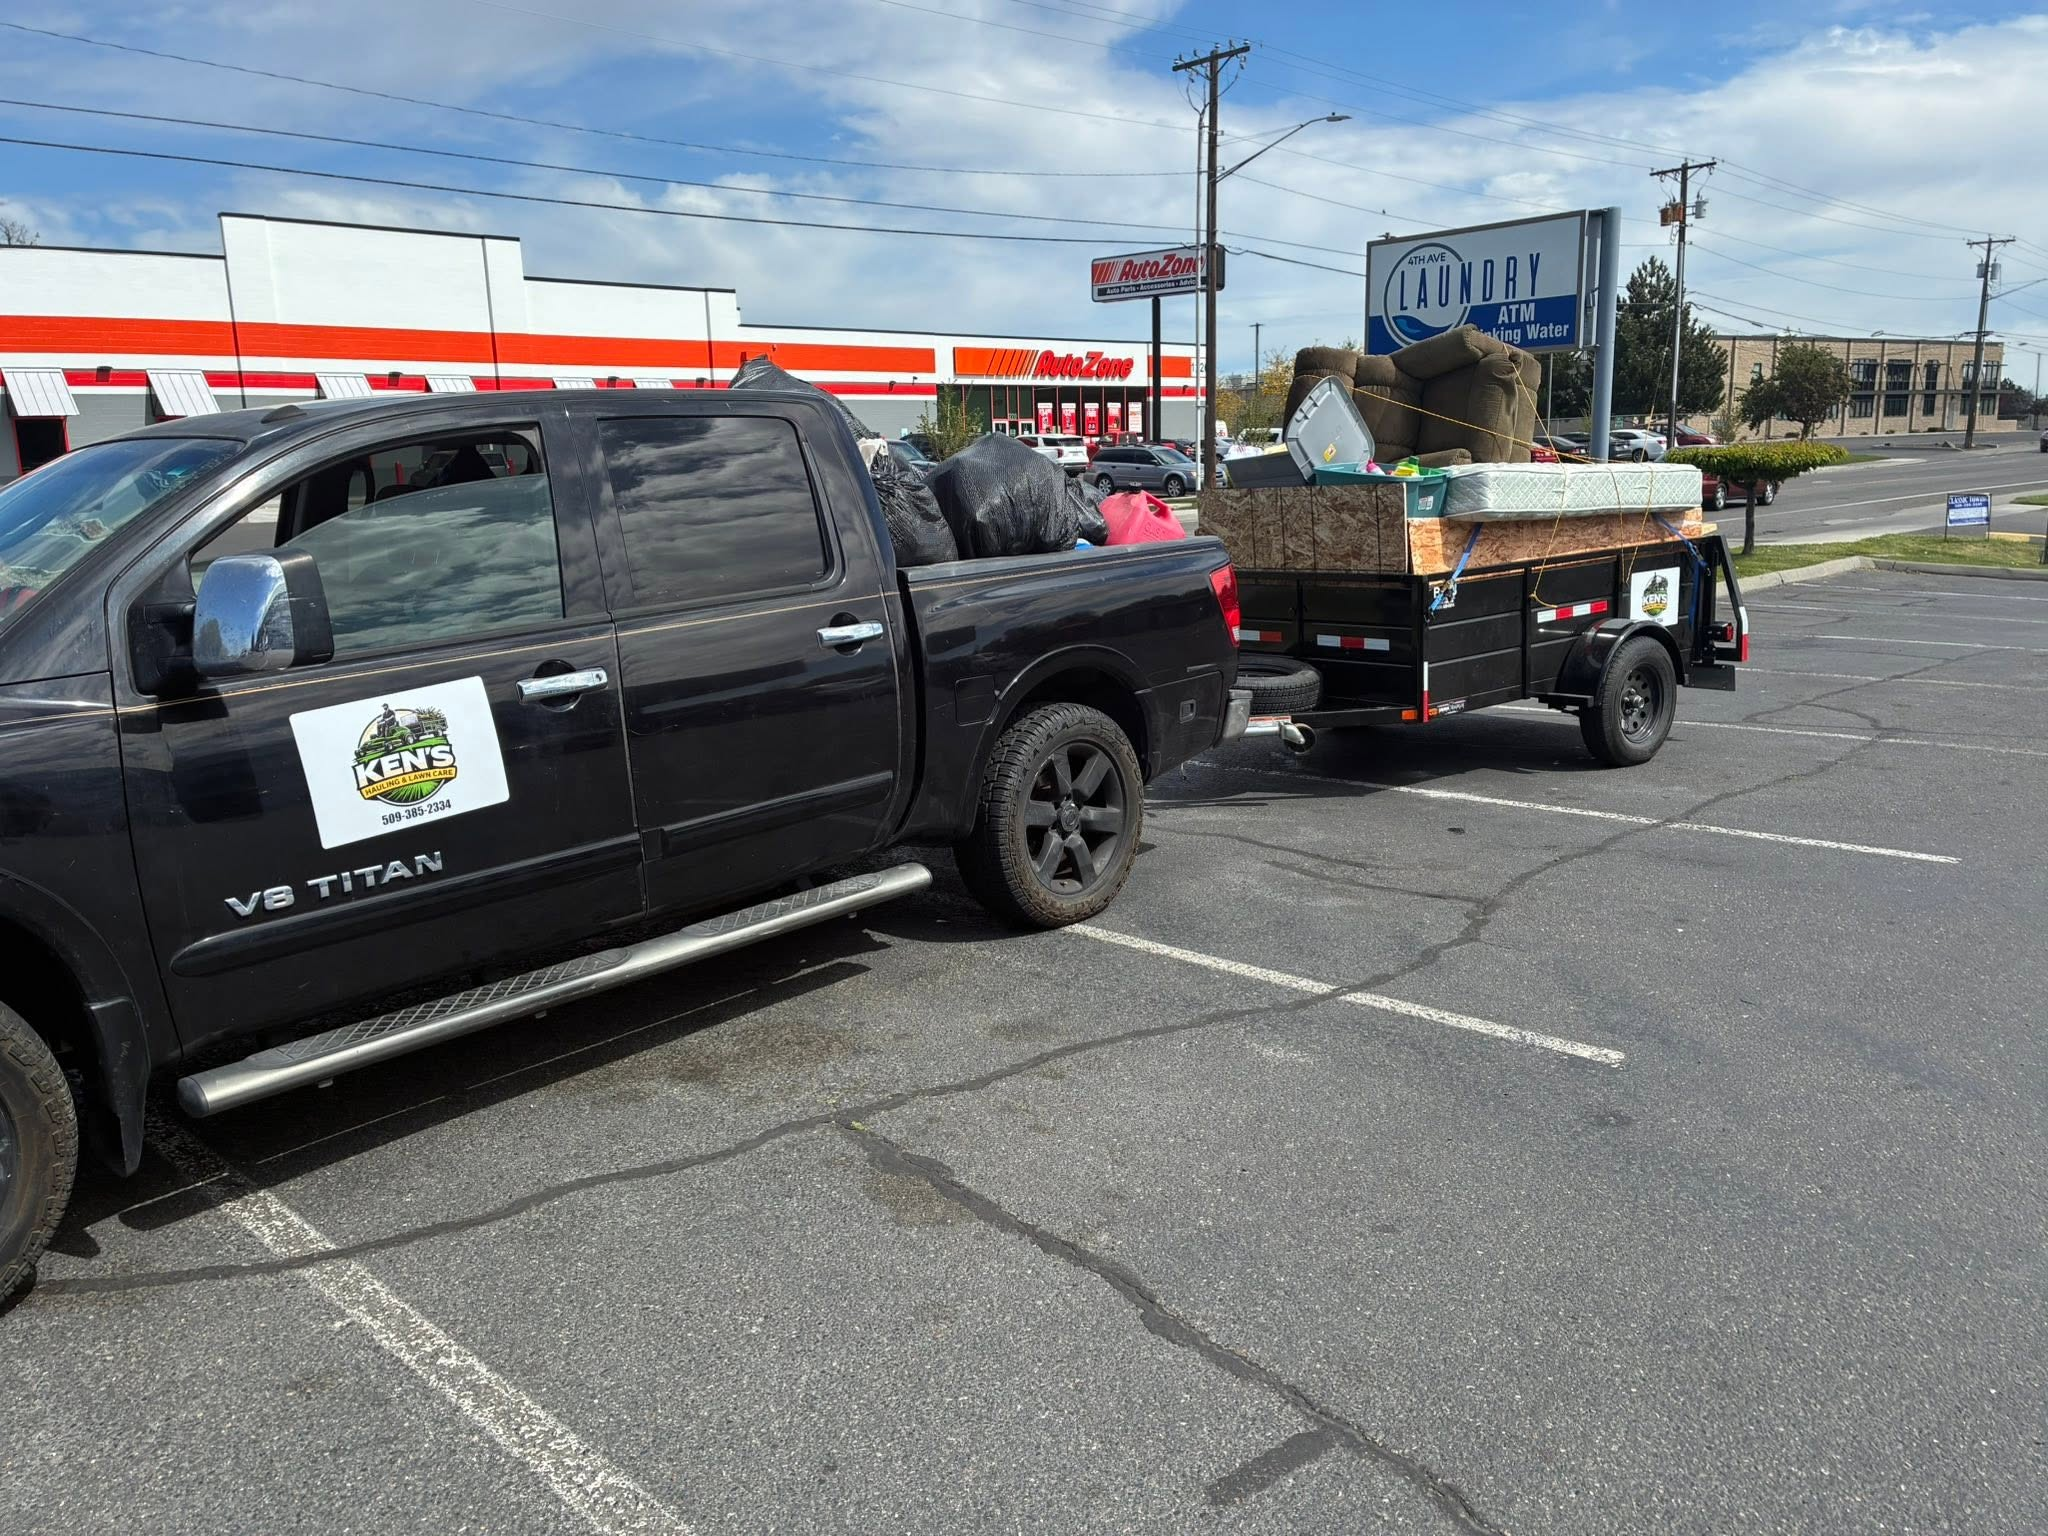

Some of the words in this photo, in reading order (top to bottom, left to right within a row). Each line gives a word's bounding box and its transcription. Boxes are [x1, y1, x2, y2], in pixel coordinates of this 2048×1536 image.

[1408, 256, 1425, 265] 4TH
[1427, 252, 1446, 263] AVE
[1106, 287, 1119, 295] Auto
[1140, 281, 1175, 291] Accessories
[1400, 253, 1540, 311] LAUNDRY
[1498, 303, 1535, 324] ATM
[1526, 323, 1569, 340] Water
[1034, 350, 1134, 378] AutoZone
[353, 744, 455, 788] KEN'S
[365, 779, 400, 796] HAULING
[408, 771, 431, 782] LAWN
[432, 769, 453, 777] CARE
[381, 799, 452, 825] 509-385-2334
[224, 885, 295, 917] V8
[306, 851, 443, 898] TITAN
